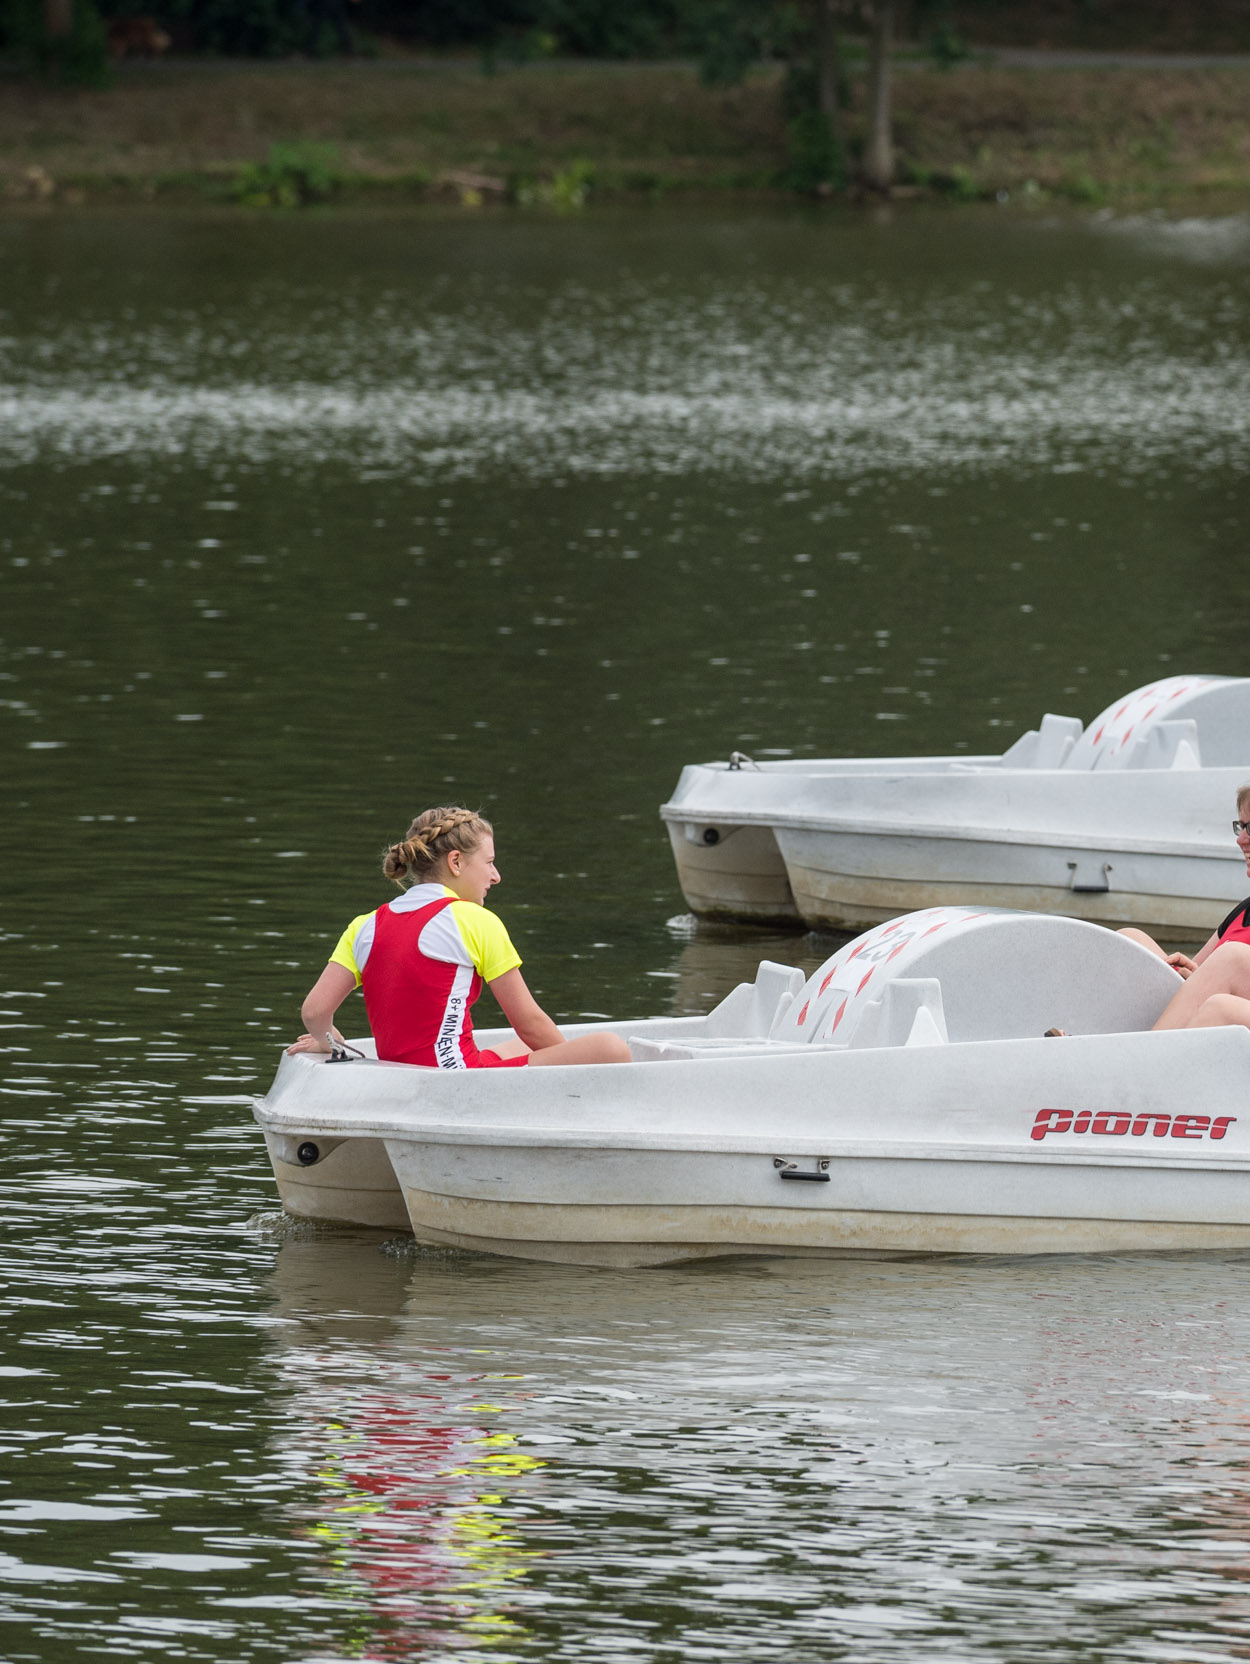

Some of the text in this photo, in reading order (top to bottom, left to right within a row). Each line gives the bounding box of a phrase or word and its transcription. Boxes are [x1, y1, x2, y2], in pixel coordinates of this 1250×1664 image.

[855, 930, 916, 962] 23
[451, 998, 461, 1011] 8+
[1031, 1109, 1237, 1140] pioner
